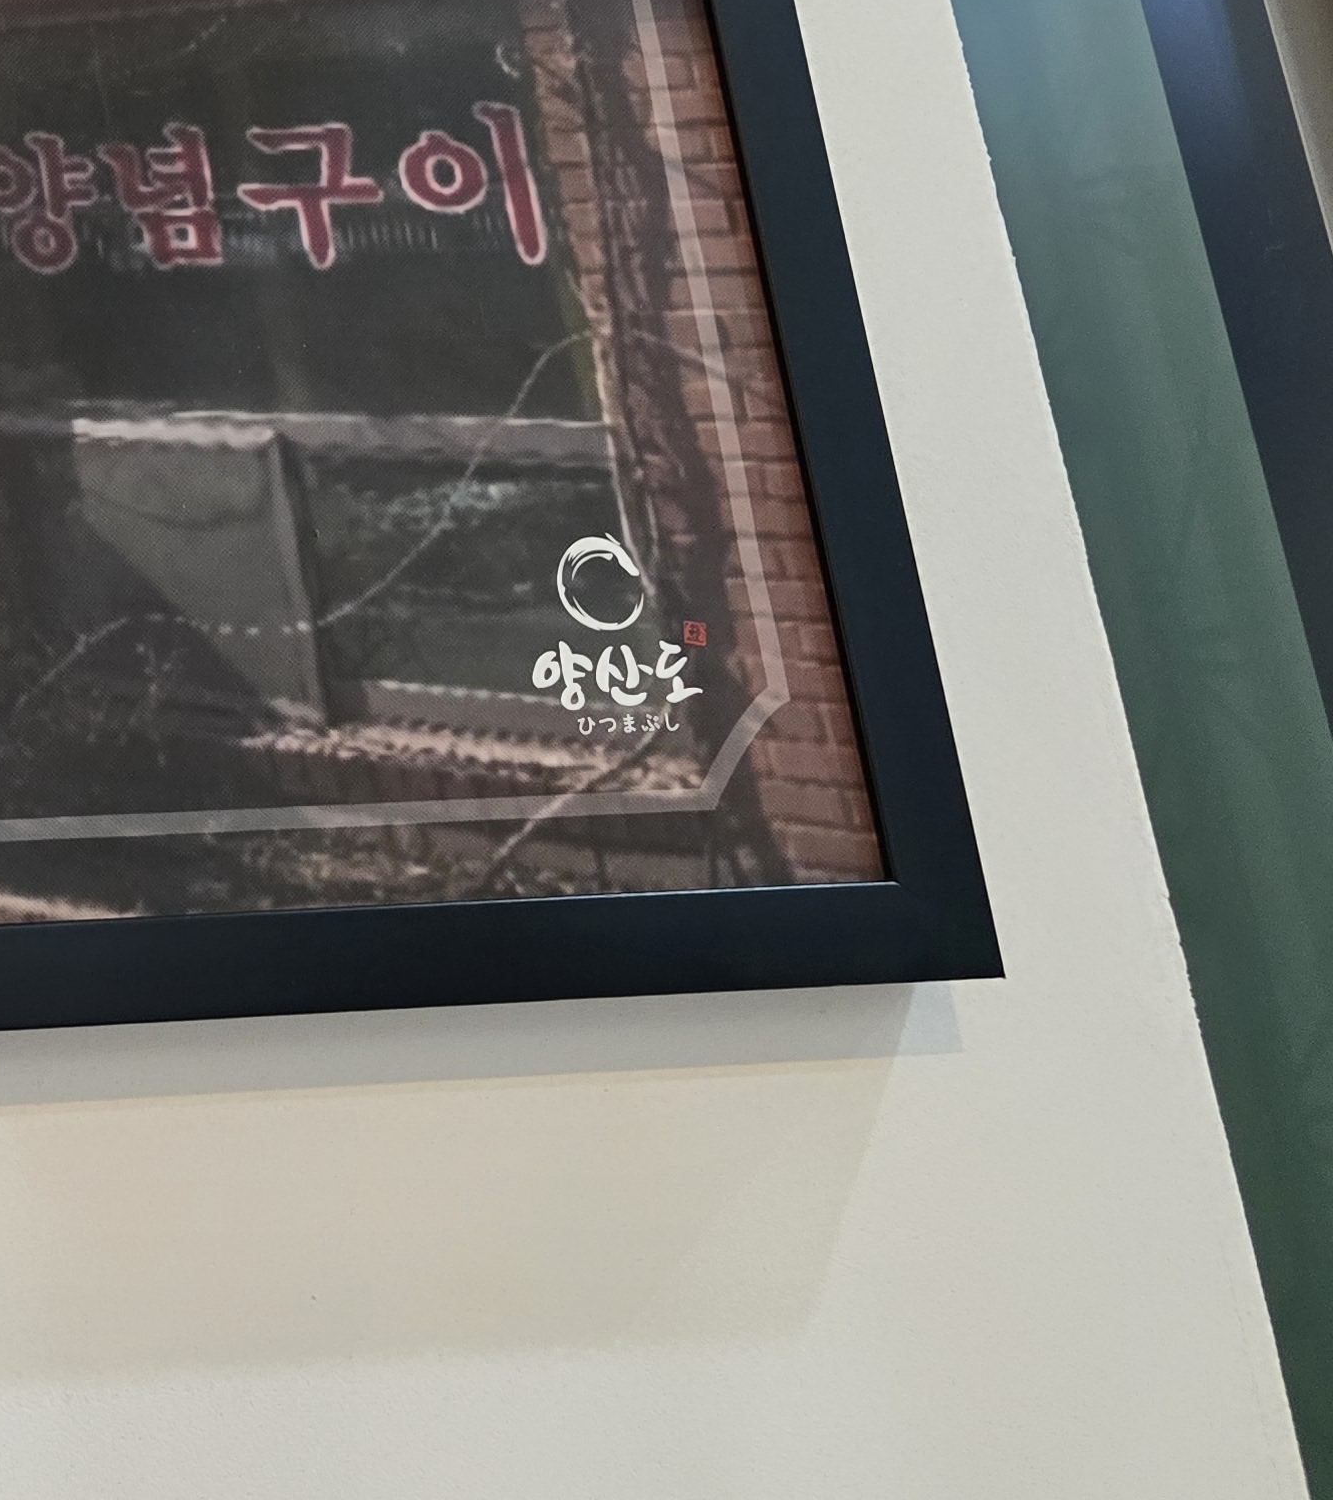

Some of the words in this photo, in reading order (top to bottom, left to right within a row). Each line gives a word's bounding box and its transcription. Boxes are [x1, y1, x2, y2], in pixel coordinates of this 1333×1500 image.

[532, 640, 704, 711] 양산도
[577, 712, 680, 736] ひつまぶし
